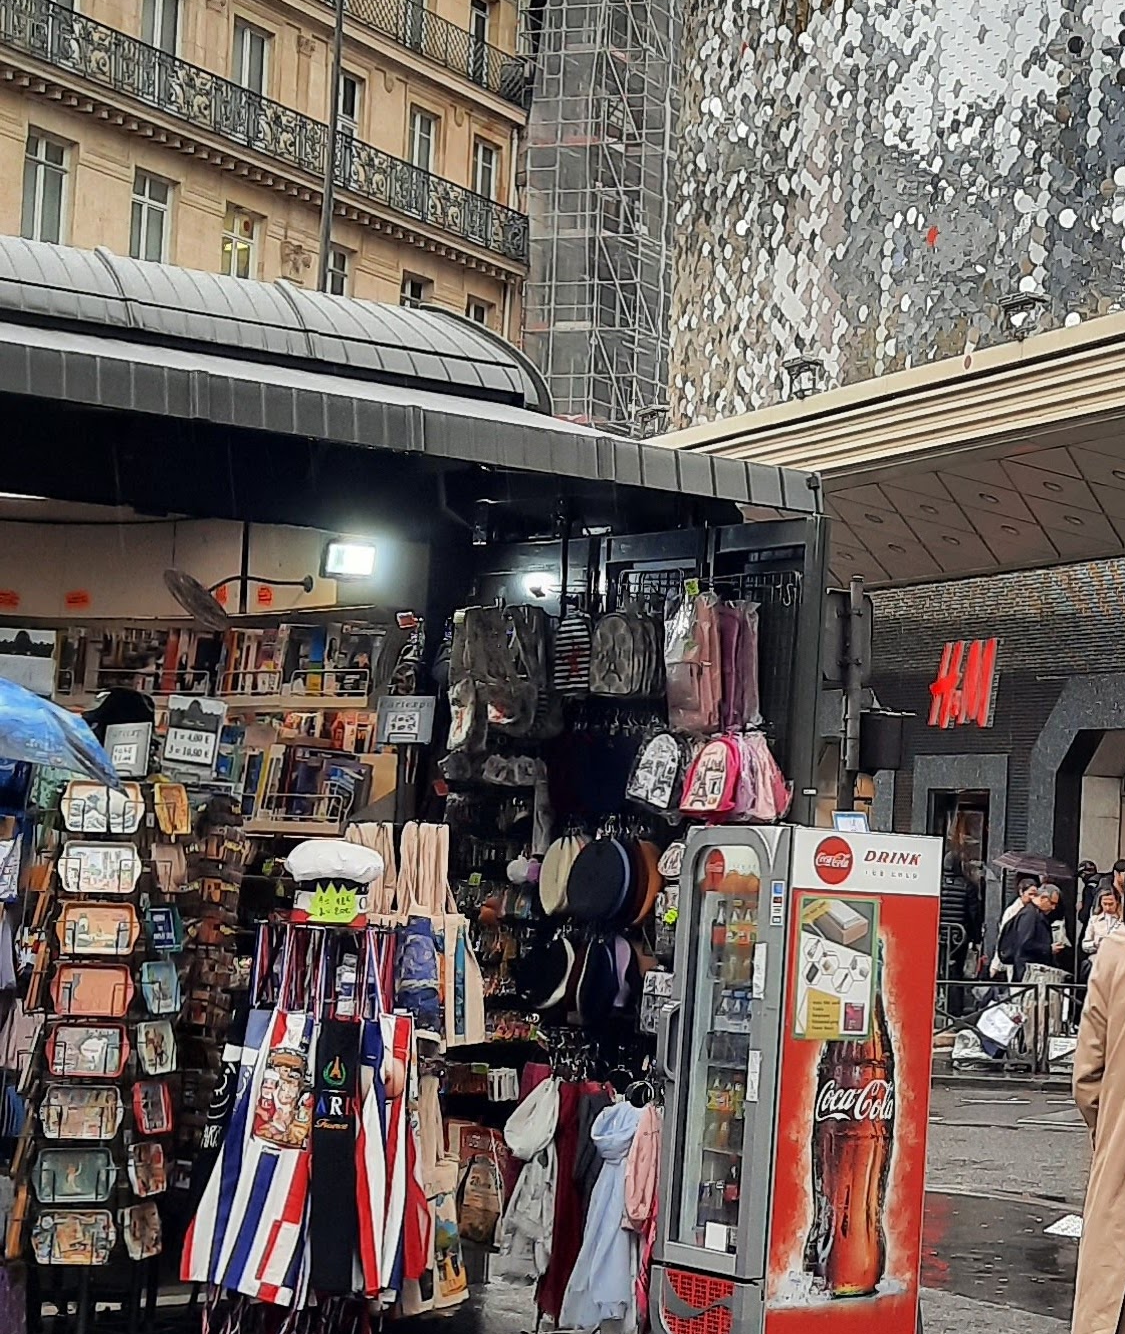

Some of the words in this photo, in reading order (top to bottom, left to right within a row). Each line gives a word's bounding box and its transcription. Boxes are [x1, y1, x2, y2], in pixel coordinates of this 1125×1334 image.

[928, 637, 1000, 729] H&M
[864, 850, 922, 866] DRINK
[815, 1078, 895, 1122] Coca-Cola
